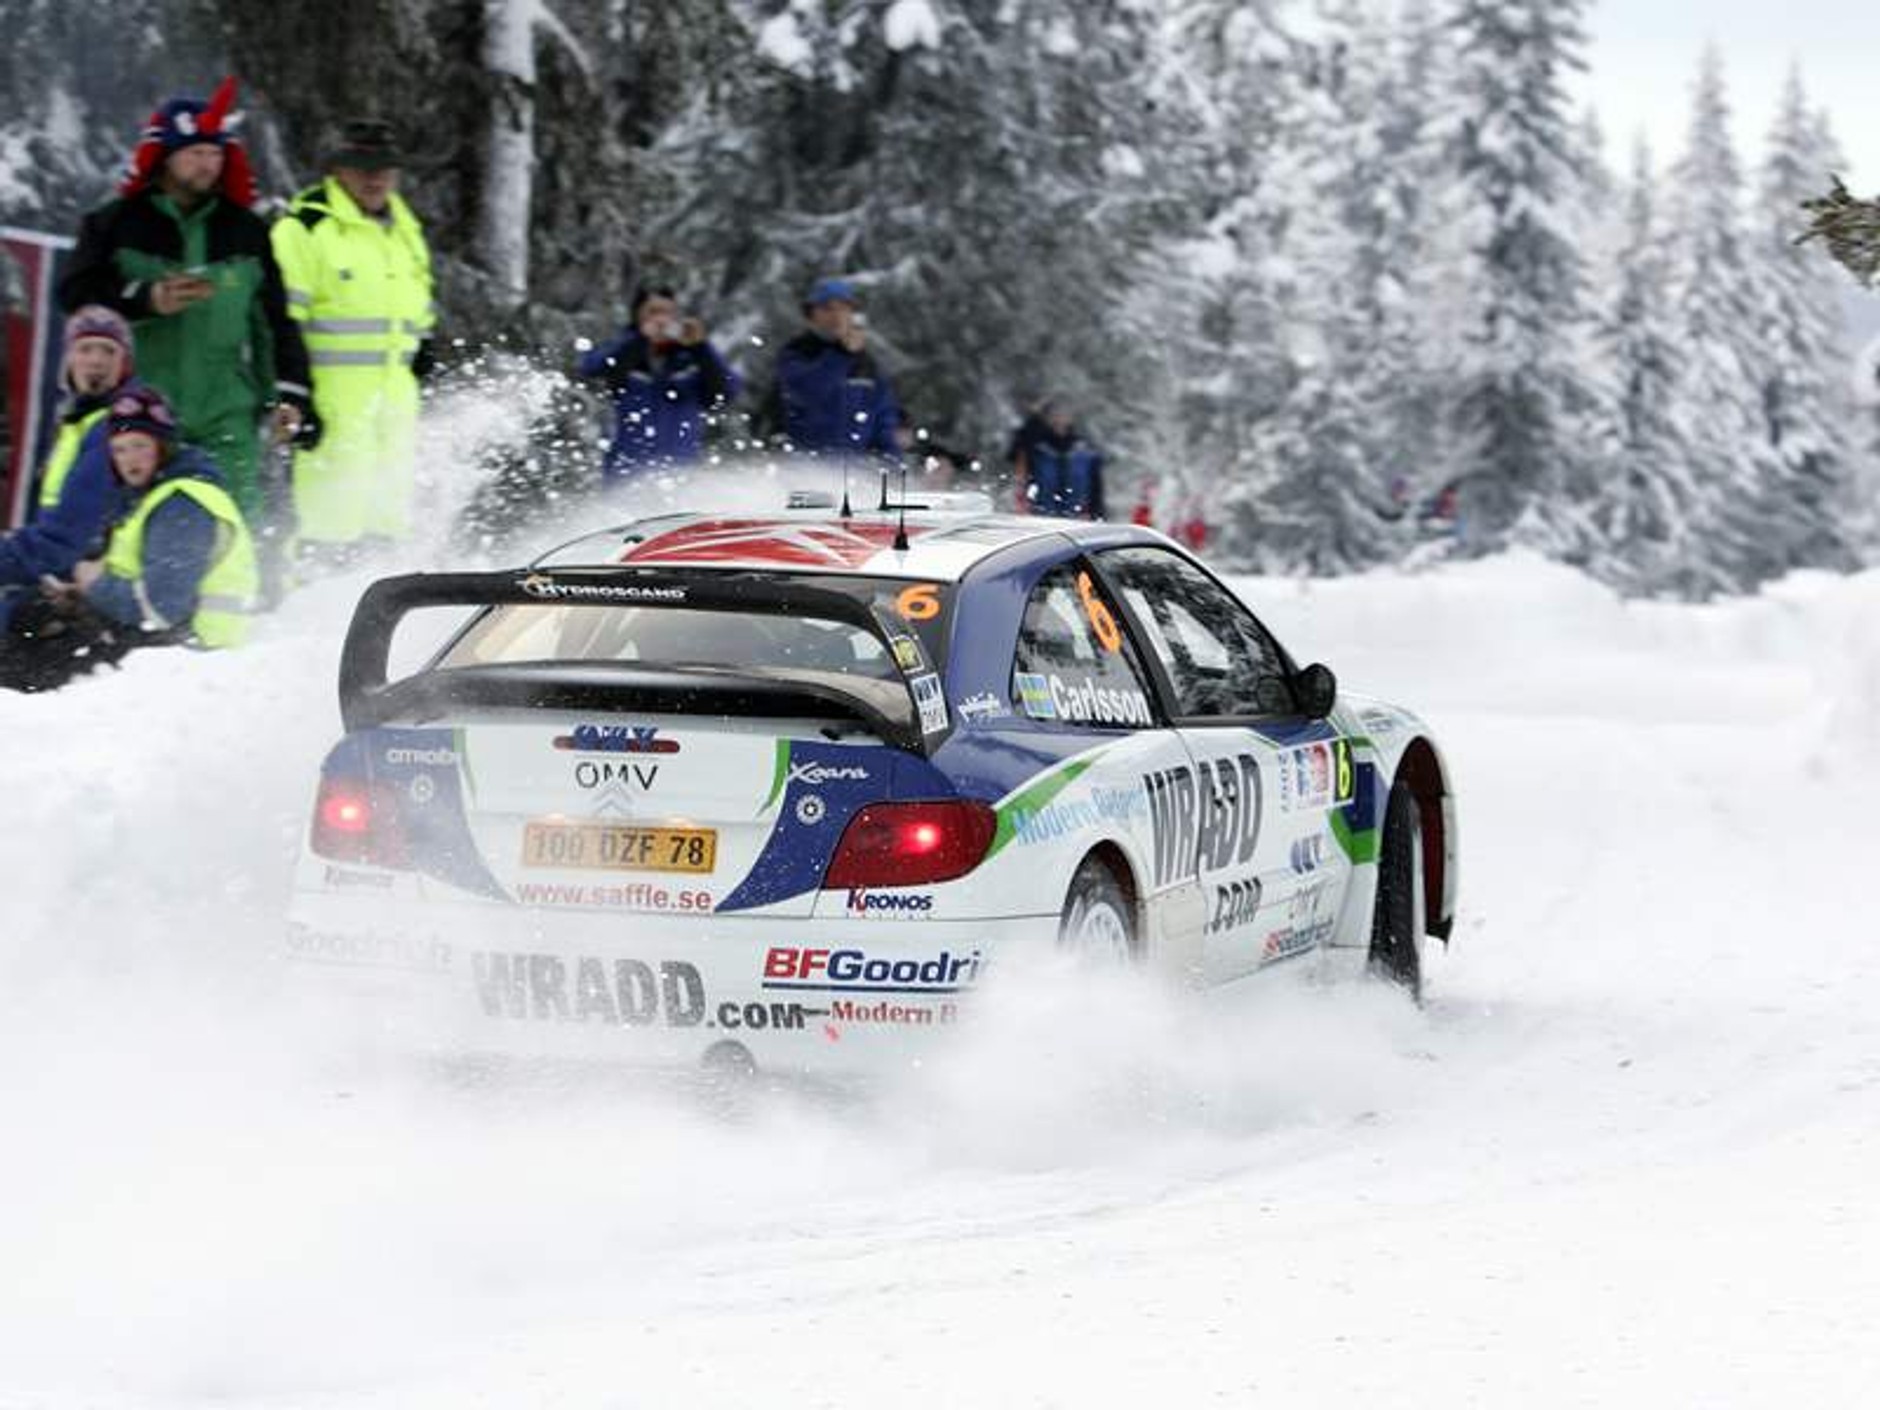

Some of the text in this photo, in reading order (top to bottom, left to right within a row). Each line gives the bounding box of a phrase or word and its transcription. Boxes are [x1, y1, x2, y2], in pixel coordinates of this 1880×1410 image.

[899, 584, 941, 620] 6
[1077, 571, 1122, 653] 6
[1050, 674, 1153, 725] Carlsson
[575, 761, 658, 790] OMV
[1336, 740, 1351, 799] 6
[1143, 753, 1263, 885] WRADD
[533, 831, 584, 864] 100
[668, 835, 706, 867] 78
[763, 946, 984, 984] BFGoodri
[831, 1000, 932, 1027] Modern
